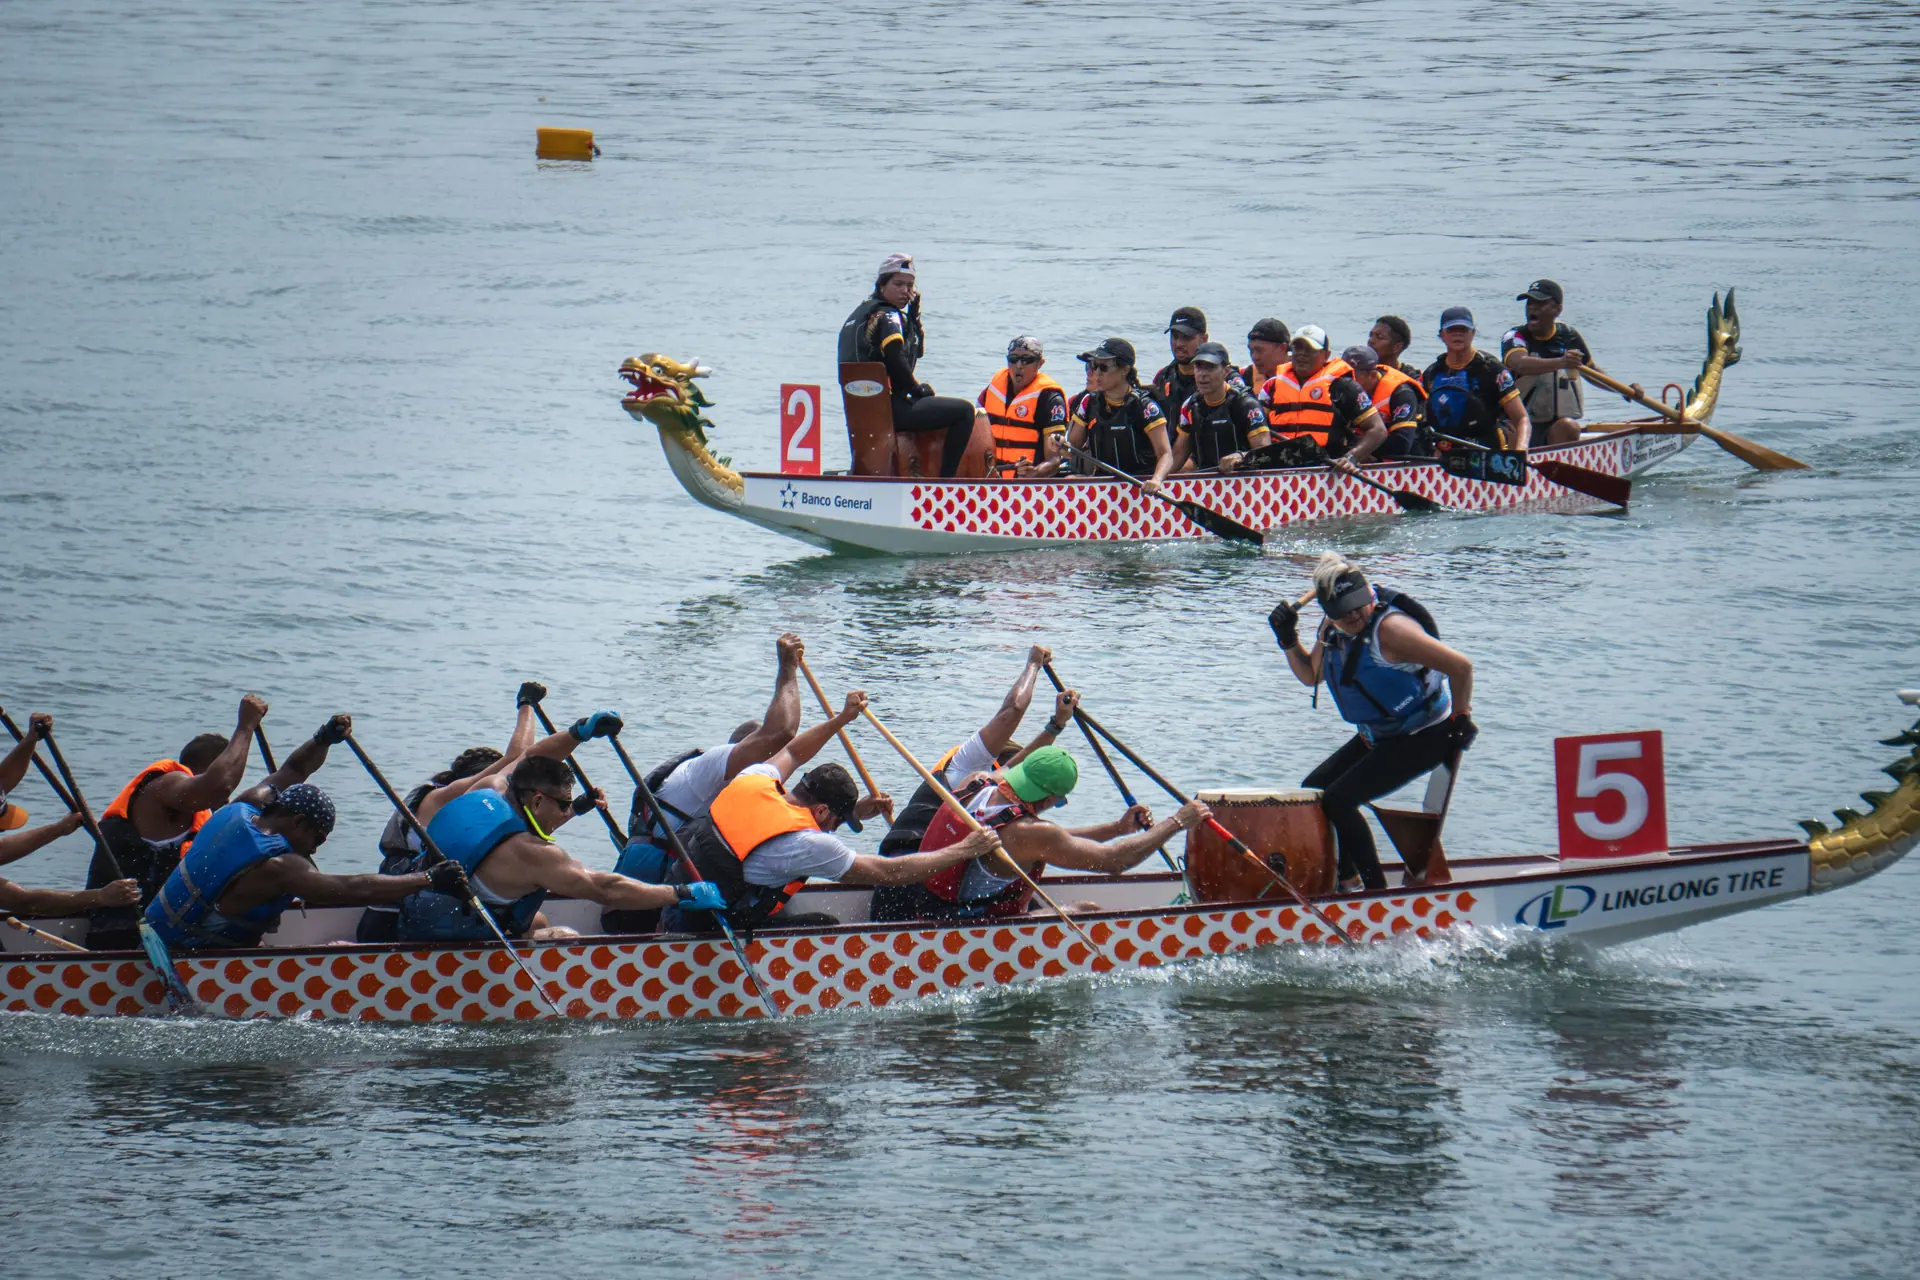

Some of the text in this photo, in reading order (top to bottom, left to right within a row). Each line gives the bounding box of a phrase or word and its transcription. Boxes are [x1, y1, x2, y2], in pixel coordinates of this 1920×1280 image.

[787, 388, 814, 462] 2
[801, 492, 873, 510] Banco General
[1573, 740, 1649, 841] 5
[1601, 867, 1786, 912] LINGLONG TIRE
